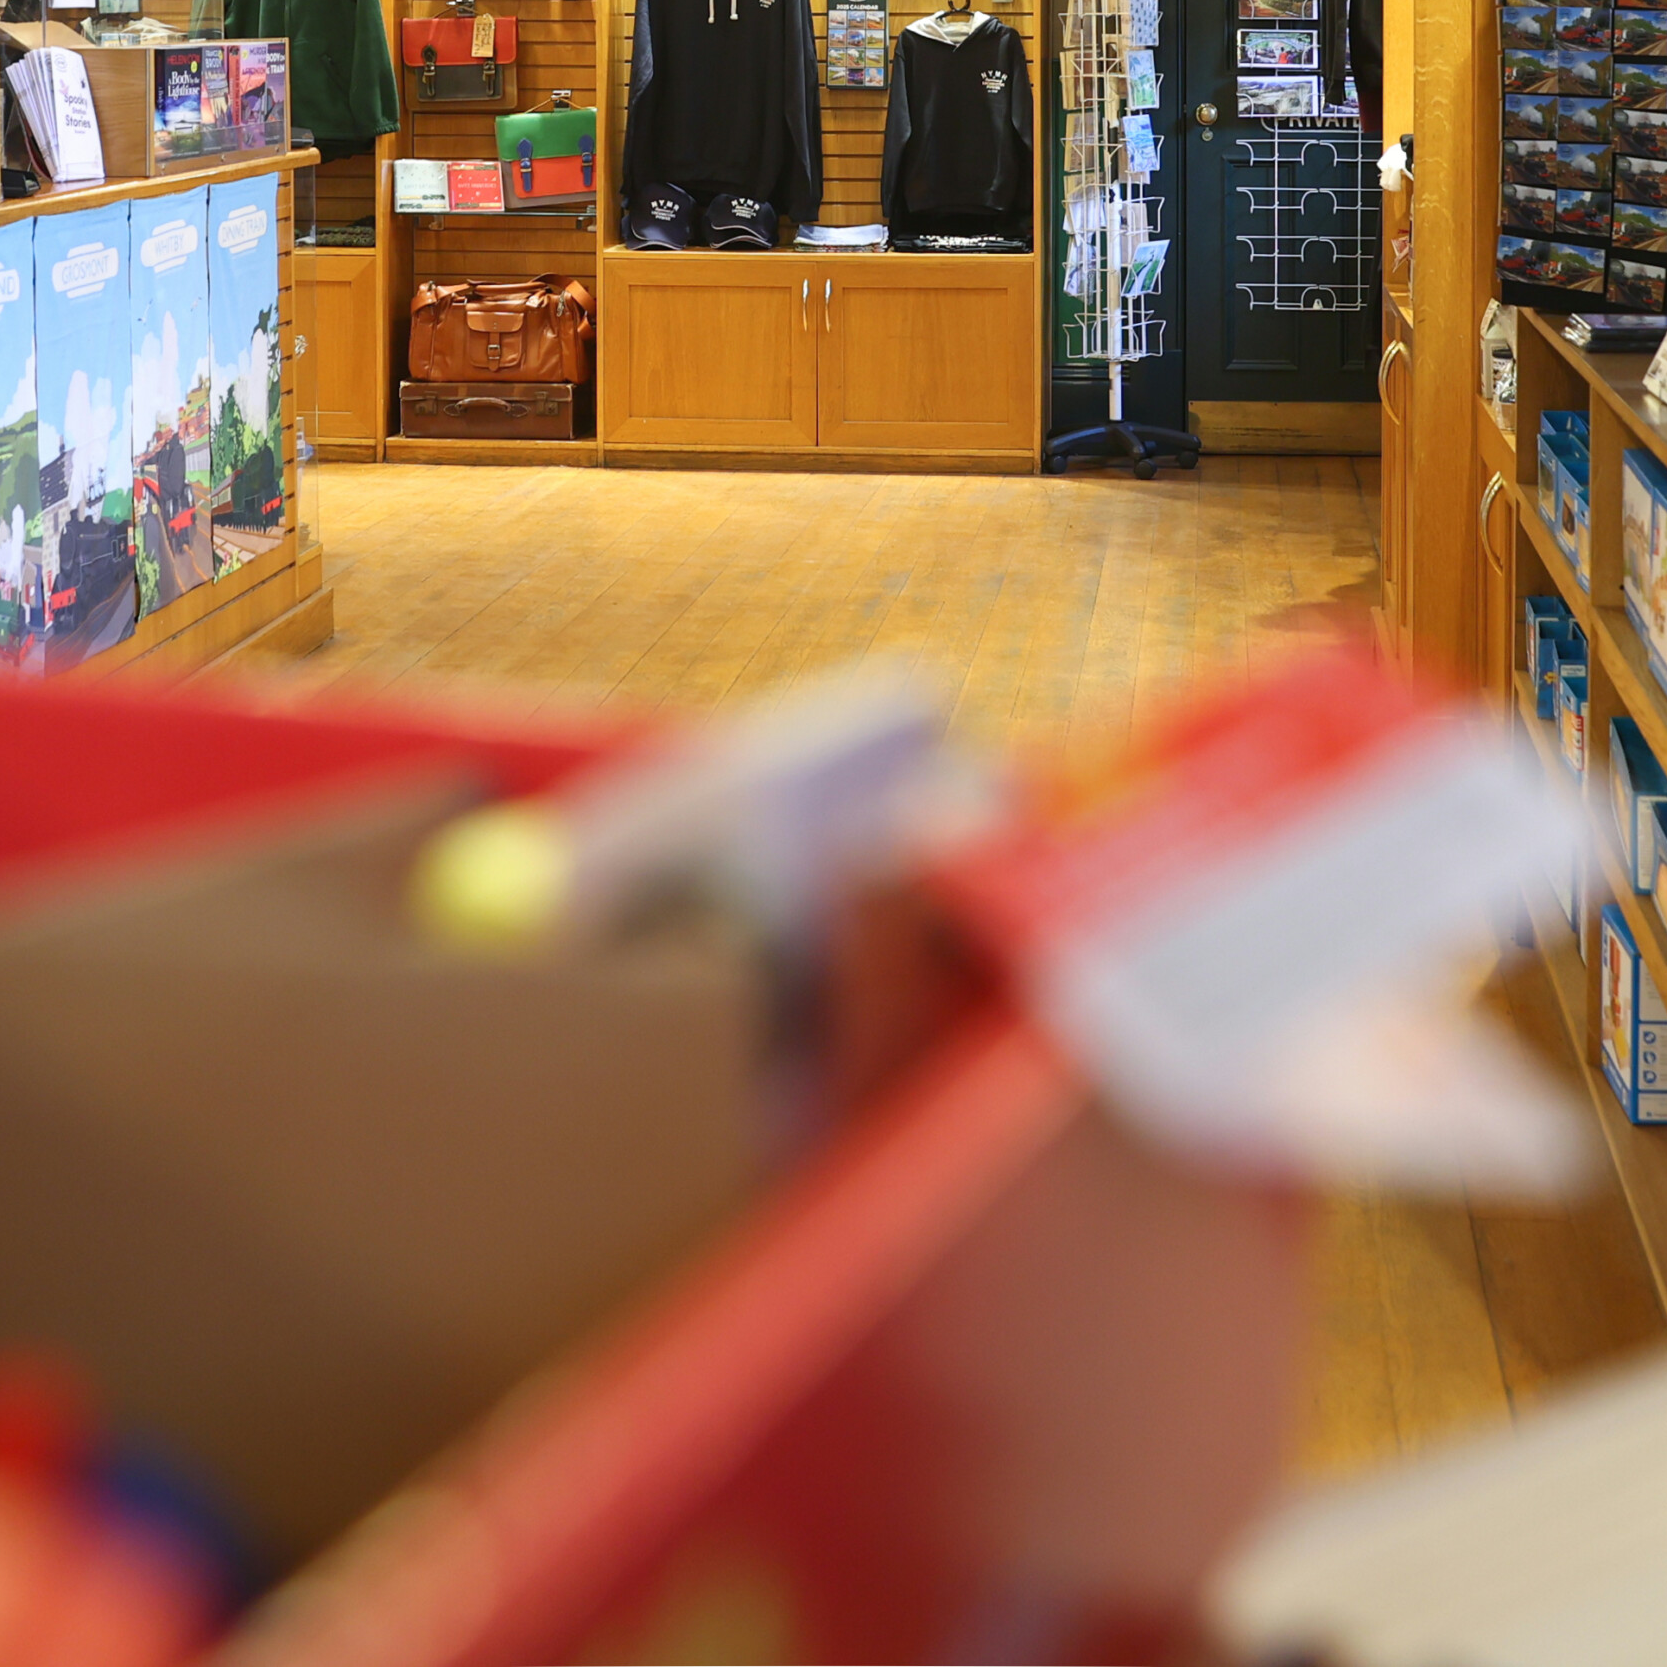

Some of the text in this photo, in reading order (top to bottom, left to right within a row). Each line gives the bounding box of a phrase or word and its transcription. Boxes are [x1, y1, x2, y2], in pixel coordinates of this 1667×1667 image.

[205, 57, 222, 69] BRODY
[269, 63, 285, 75] TRAIN
[171, 70, 190, 83] Body
[167, 83, 201, 101] Lighthouse
[63, 93, 88, 109] Spooky
[65, 114, 92, 129] Stories
[650, 198, 681, 213] NYMR
[730, 197, 761, 211] NYMR
[153, 232, 184, 257] WHITBY
[61, 254, 110, 285] GROSMONT
